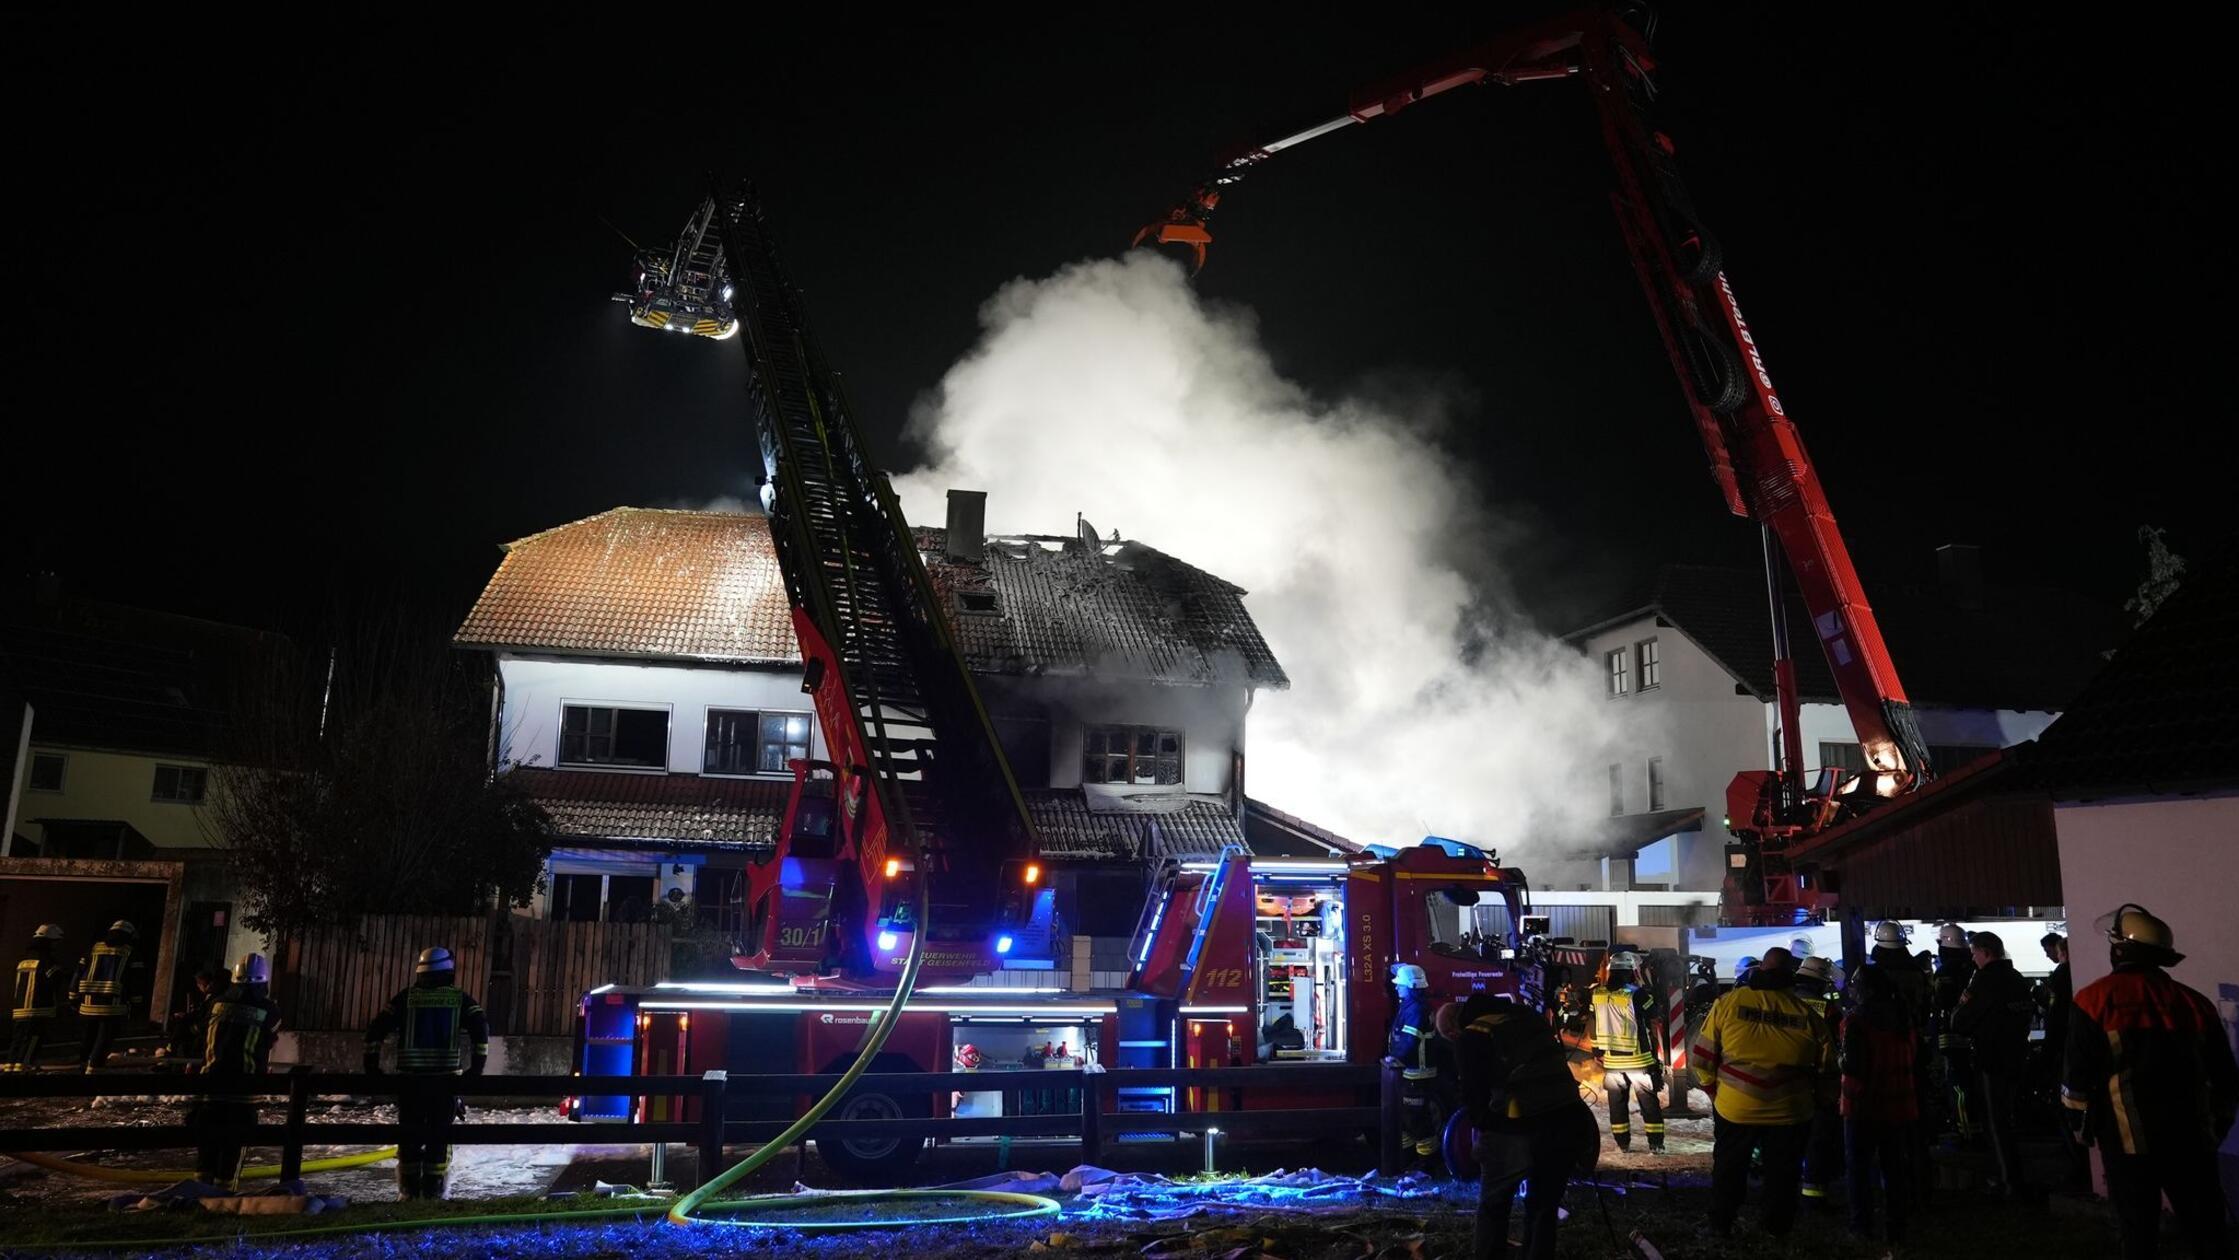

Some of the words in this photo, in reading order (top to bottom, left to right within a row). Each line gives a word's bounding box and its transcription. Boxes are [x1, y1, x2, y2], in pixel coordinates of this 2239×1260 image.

[1362, 914, 1372, 932] 3.0
[780, 927, 820, 948] 30/1
[1362, 935, 1372, 951] XS
[920, 952, 977, 960] EUERWEHR
[1205, 968, 1243, 988] 112
[1362, 954, 1373, 983] L32A
